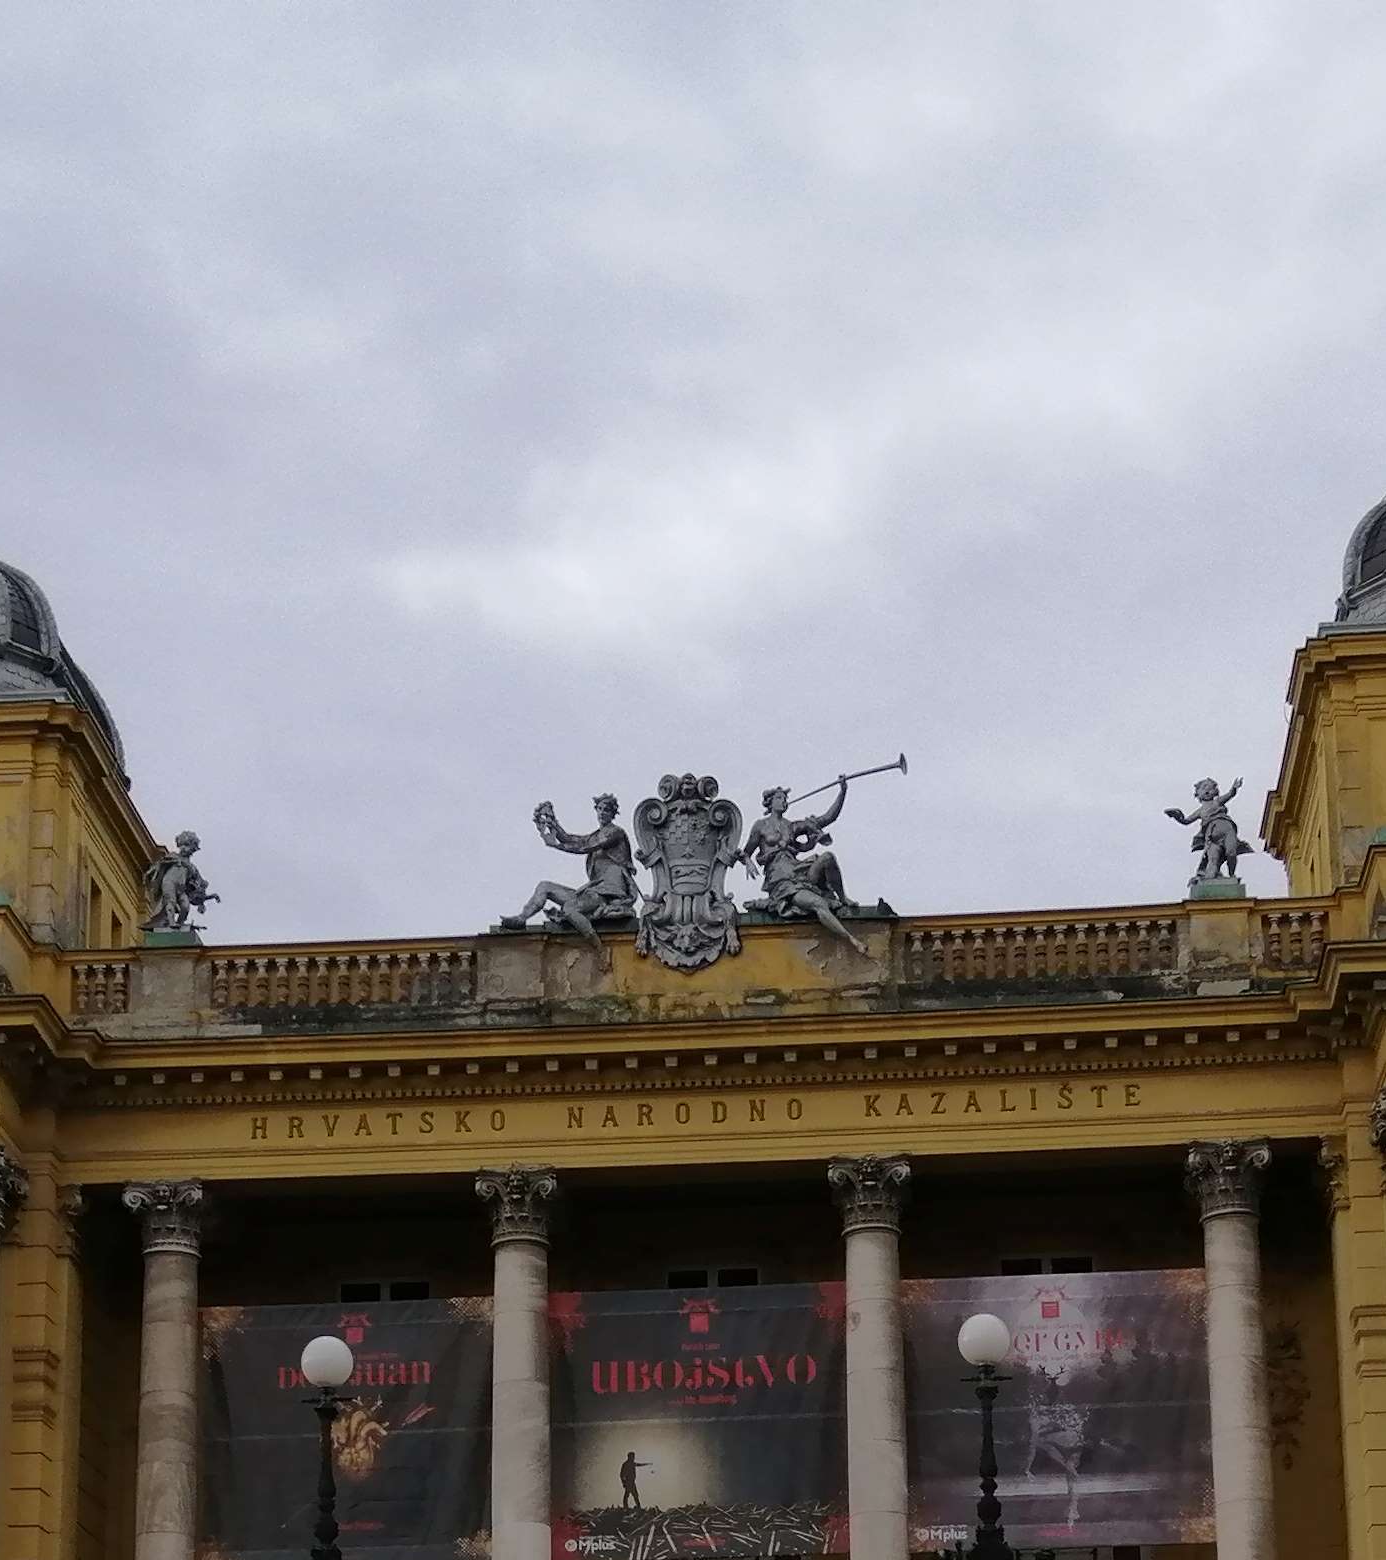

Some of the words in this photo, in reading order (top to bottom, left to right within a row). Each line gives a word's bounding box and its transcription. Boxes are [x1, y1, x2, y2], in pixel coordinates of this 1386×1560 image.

[251, 1110, 505, 1140] HRVATSKO
[567, 1098, 804, 1128] NARODNO
[864, 1082, 1142, 1117] KAZALIŠTE
